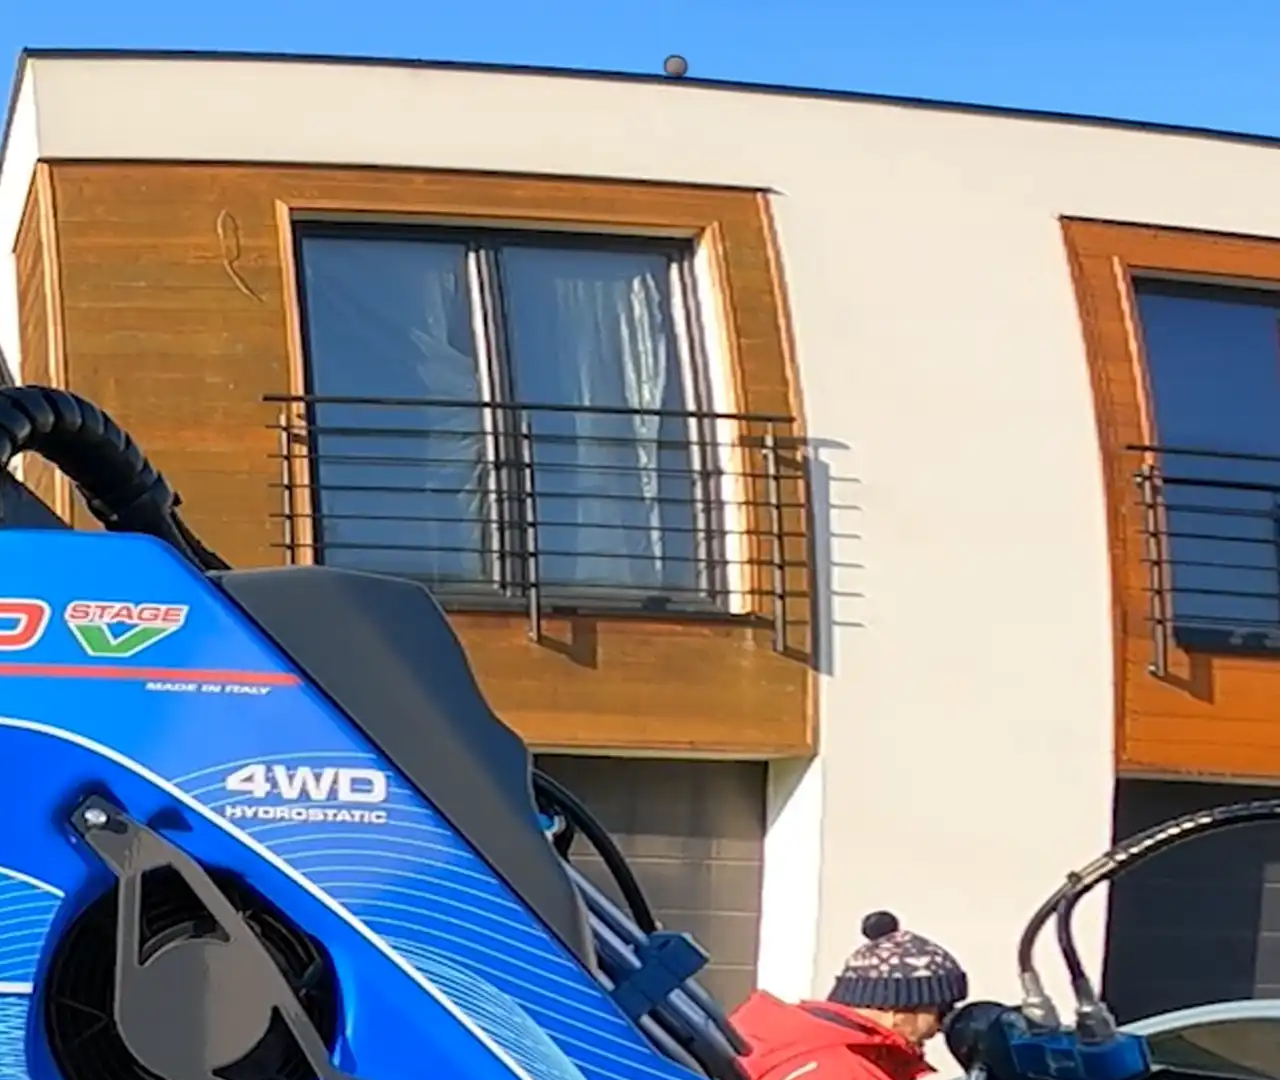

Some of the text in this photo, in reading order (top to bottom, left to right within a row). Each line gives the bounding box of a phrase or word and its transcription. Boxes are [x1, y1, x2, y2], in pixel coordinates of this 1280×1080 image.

[65, 600, 189, 624] STAGE
[68, 622, 181, 657] V
[144, 681, 271, 696] MADE IN ITALY
[224, 764, 388, 803] 4WD
[225, 804, 389, 824] HYDROSTATIC
